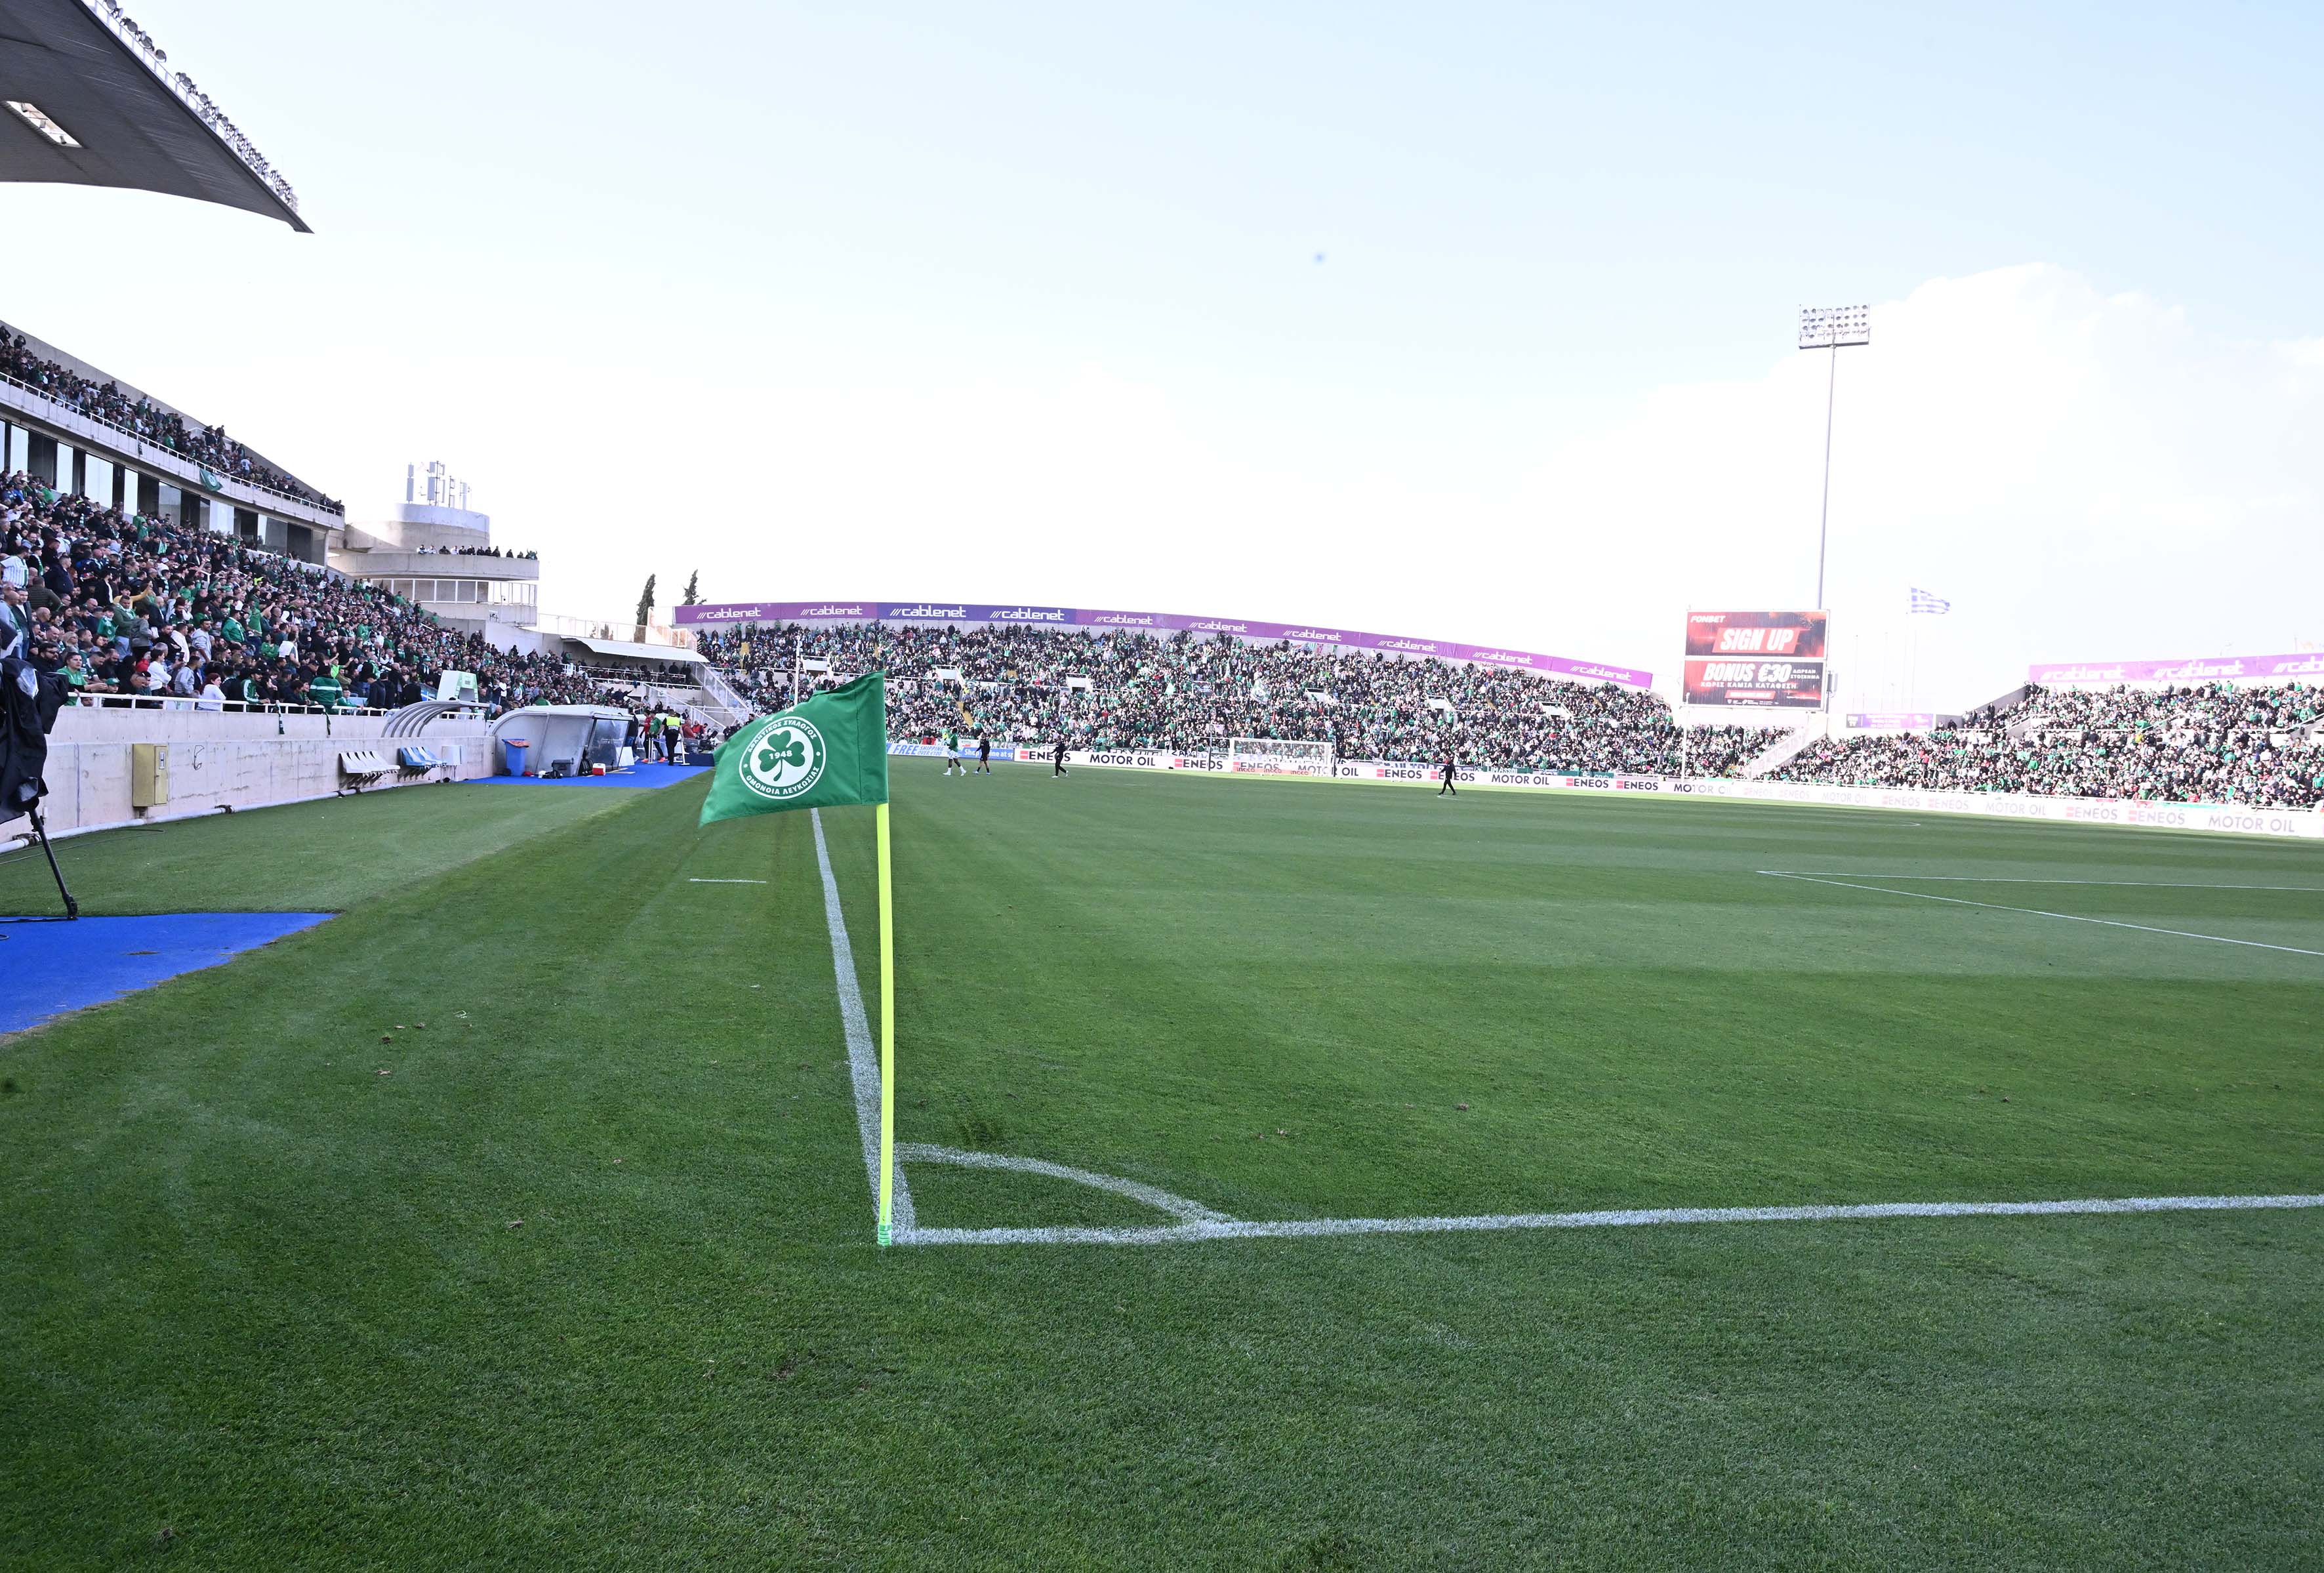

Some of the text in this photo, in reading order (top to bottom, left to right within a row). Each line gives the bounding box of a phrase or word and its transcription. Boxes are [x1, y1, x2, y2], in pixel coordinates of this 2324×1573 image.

[706, 607, 761, 619] cablenet
[810, 605, 862, 615] cablenet
[901, 605, 966, 618] cablenet
[1002, 608, 1065, 621] cablenet
[1103, 614, 1152, 625] cablenet
[1197, 621, 1247, 632] cablenet
[1292, 629, 1341, 642] cablenet
[1720, 629, 1794, 651] SIGN UP
[1387, 640, 1437, 652] cablenet
[1482, 651, 1532, 665] cablenet
[2287, 656, 2324, 672] cab
[1580, 666, 1631, 682] cablenet
[1703, 663, 1793, 682] BONUS €30
[2167, 659, 2244, 678] cablenet
[783, 720, 817, 740] ΣΥΛΛΟΓΟΣ
[769, 750, 792, 760] 1948
[893, 744, 918, 754] FREE
[1029, 751, 1070, 762] ENES
[1090, 754, 1155, 766] MOTOR OIL
[1183, 759, 1223, 769] ENEOS
[1341, 767, 1358, 776] OIL
[1385, 769, 1422, 779] ENEOS
[1438, 771, 1475, 781] EEOS
[746, 766, 820, 795] ΟΜΟΝΟΙΑ ΛΕΥΚΩΣΙΑΣ
[1492, 774, 1549, 785] MOTOR OIL
[1574, 778, 1609, 788] ENEOS
[1624, 781, 1658, 790] ENEOS
[1674, 783, 1713, 794] MOTOR
[1822, 792, 1867, 803] MOTOR OIL
[1888, 796, 1920, 807] ENEOS
[1935, 798, 1968, 810] ENEOS
[1986, 802, 2046, 815] MOTOR OIL
[2075, 807, 2118, 820] ENEOS
[2138, 810, 2185, 825] ENEOS
[2209, 815, 2295, 832] MOTOR OIL
